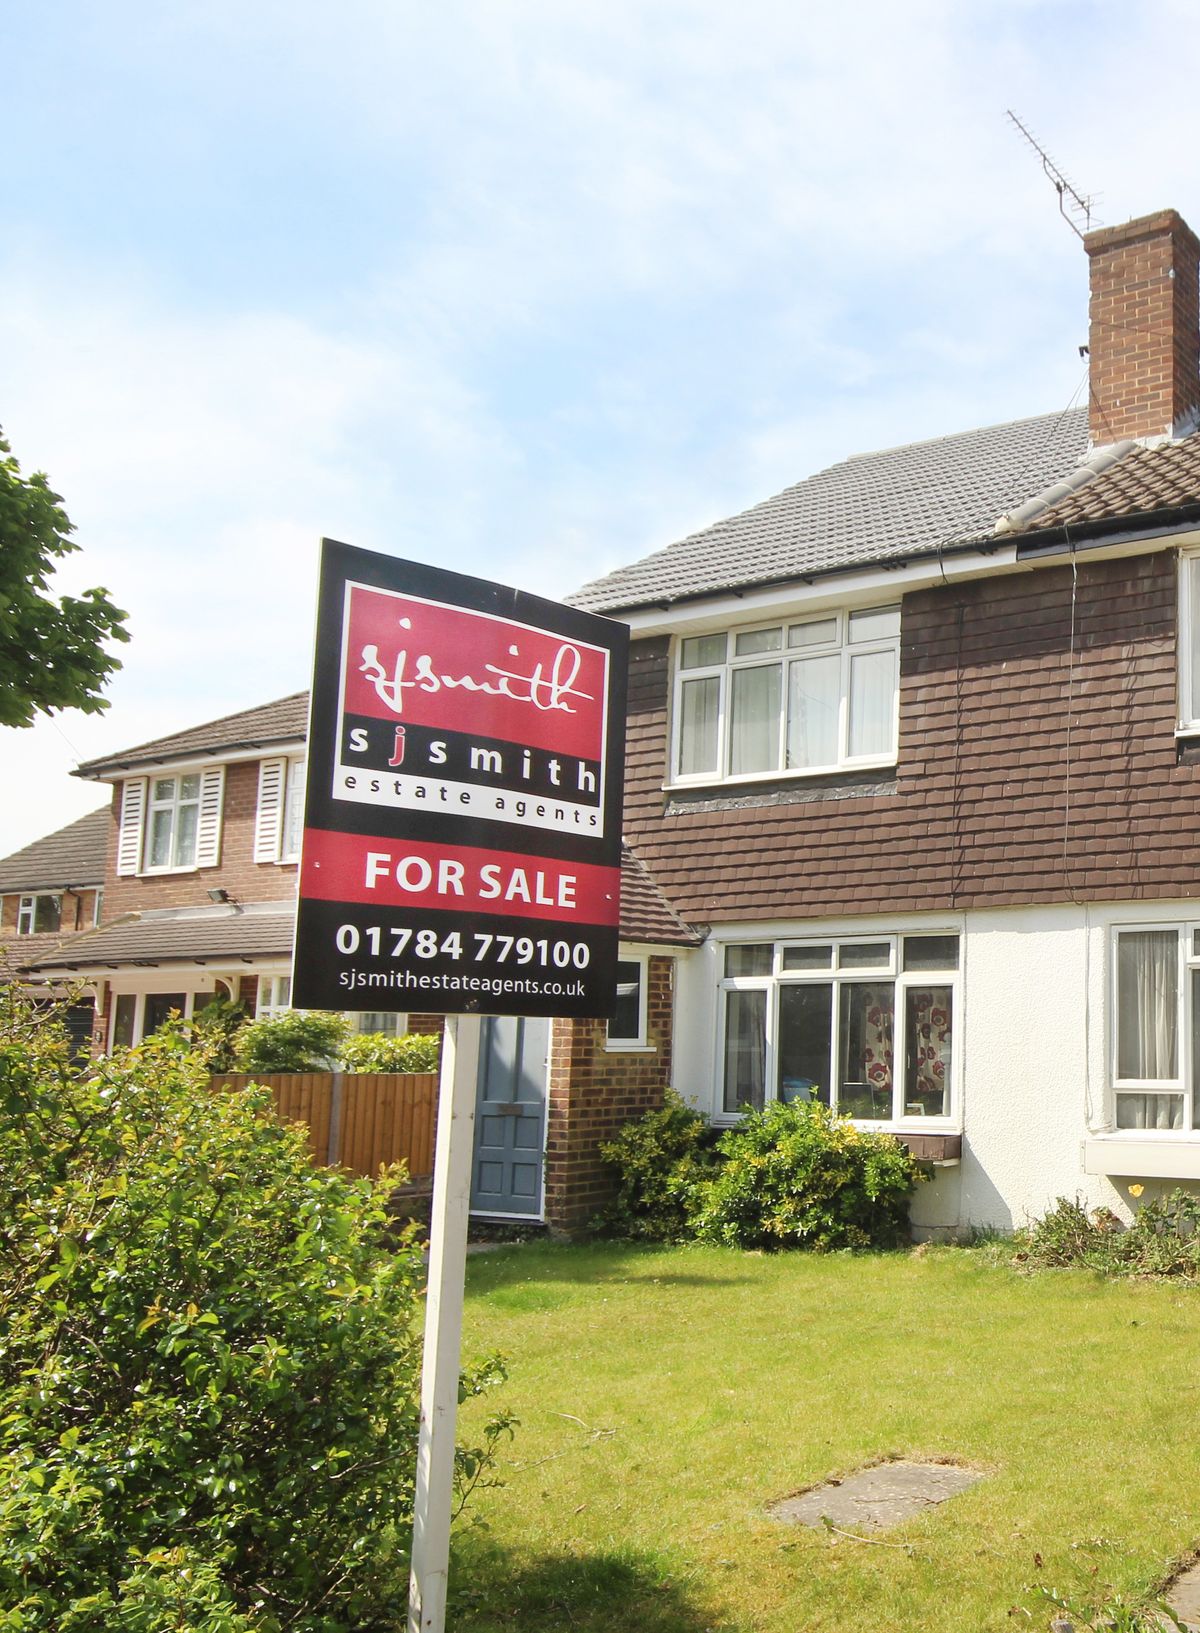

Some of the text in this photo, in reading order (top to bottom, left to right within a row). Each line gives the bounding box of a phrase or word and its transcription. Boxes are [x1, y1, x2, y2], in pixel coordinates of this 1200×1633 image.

[344, 776, 597, 826] estate agents
[365, 852, 577, 909] FOR SALE
[336, 925, 590, 969] 01784 779100
[339, 969, 585, 996] sjsmithestateagents.co.uk
